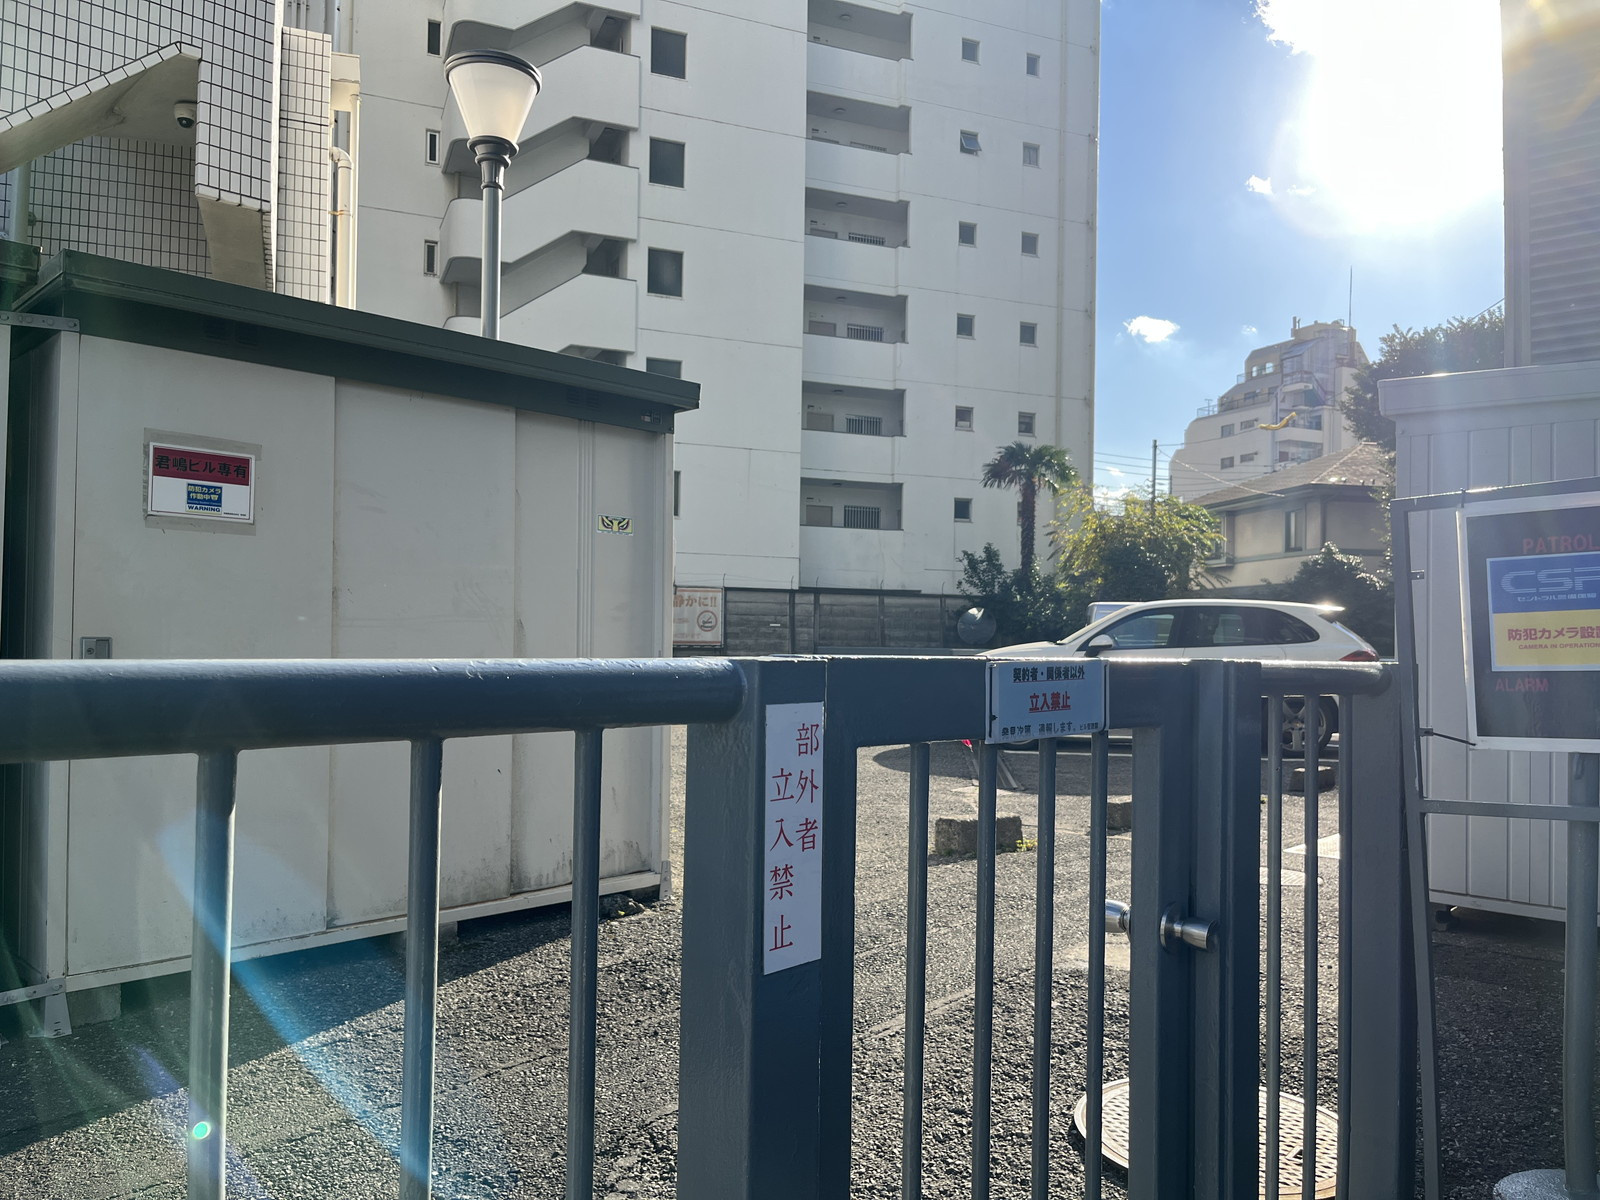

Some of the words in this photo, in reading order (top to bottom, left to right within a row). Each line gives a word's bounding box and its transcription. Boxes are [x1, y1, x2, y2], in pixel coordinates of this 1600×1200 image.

[187, 485, 221, 494] 防犯カメラ
[188, 505, 220, 513] WARNING
[1522, 533, 1600, 554] PATROL
[1495, 677, 1549, 692] ALARM
[1029, 691, 1071, 711] 立入禁止
[795, 723, 819, 852] 部外者
[769, 767, 795, 951] 立入禁止
